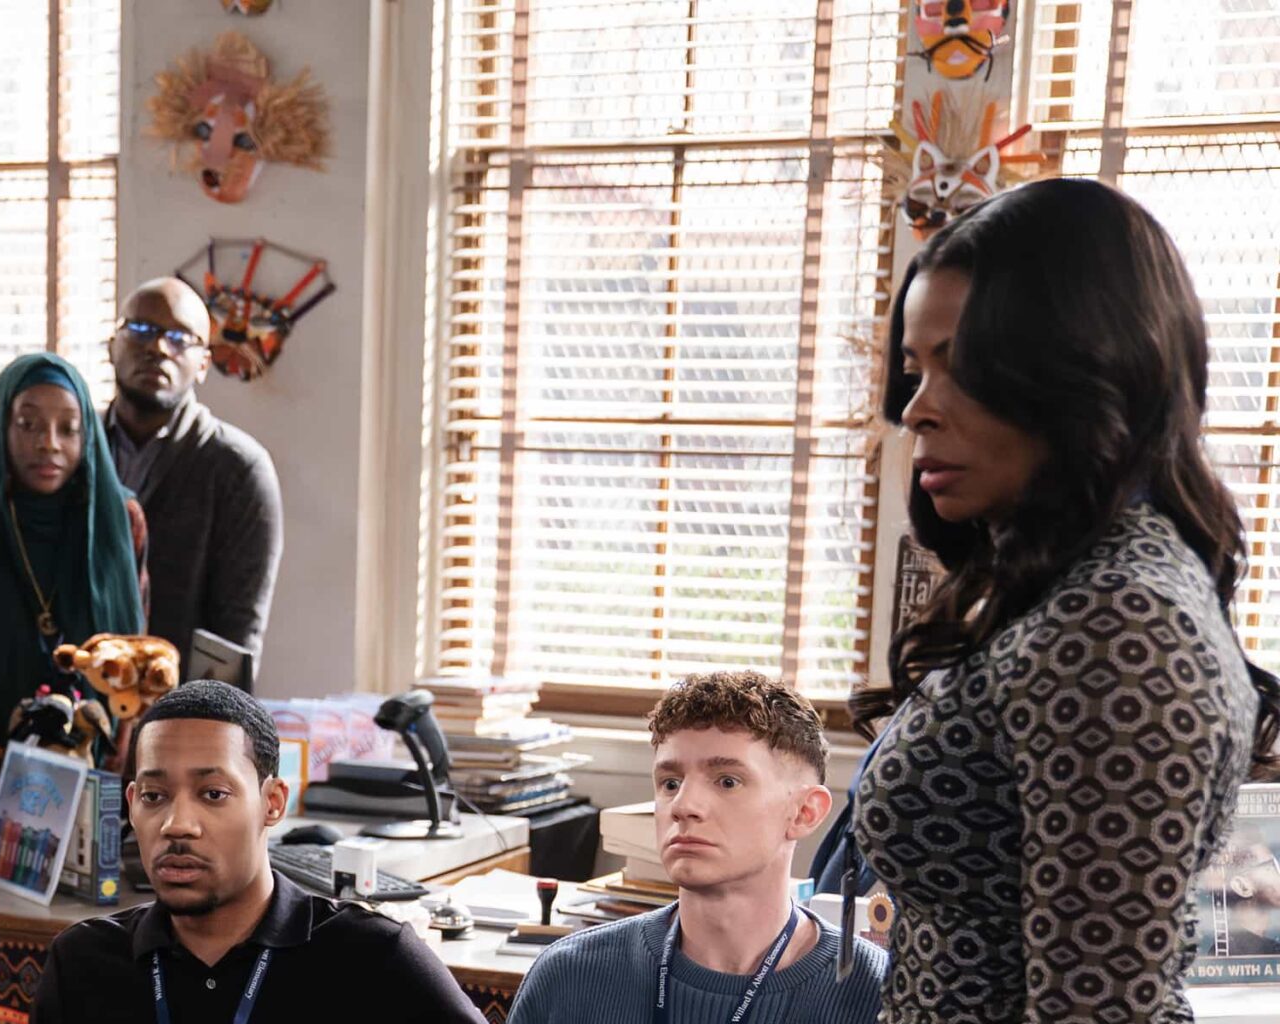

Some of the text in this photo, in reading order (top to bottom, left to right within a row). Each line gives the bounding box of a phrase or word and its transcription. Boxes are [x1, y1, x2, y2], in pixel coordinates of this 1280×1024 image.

[656, 966, 668, 1009] Elementary
[731, 933, 788, 1022] Willard R. Abbott Elementary
[1185, 963, 1274, 977] A BOY WITH A
